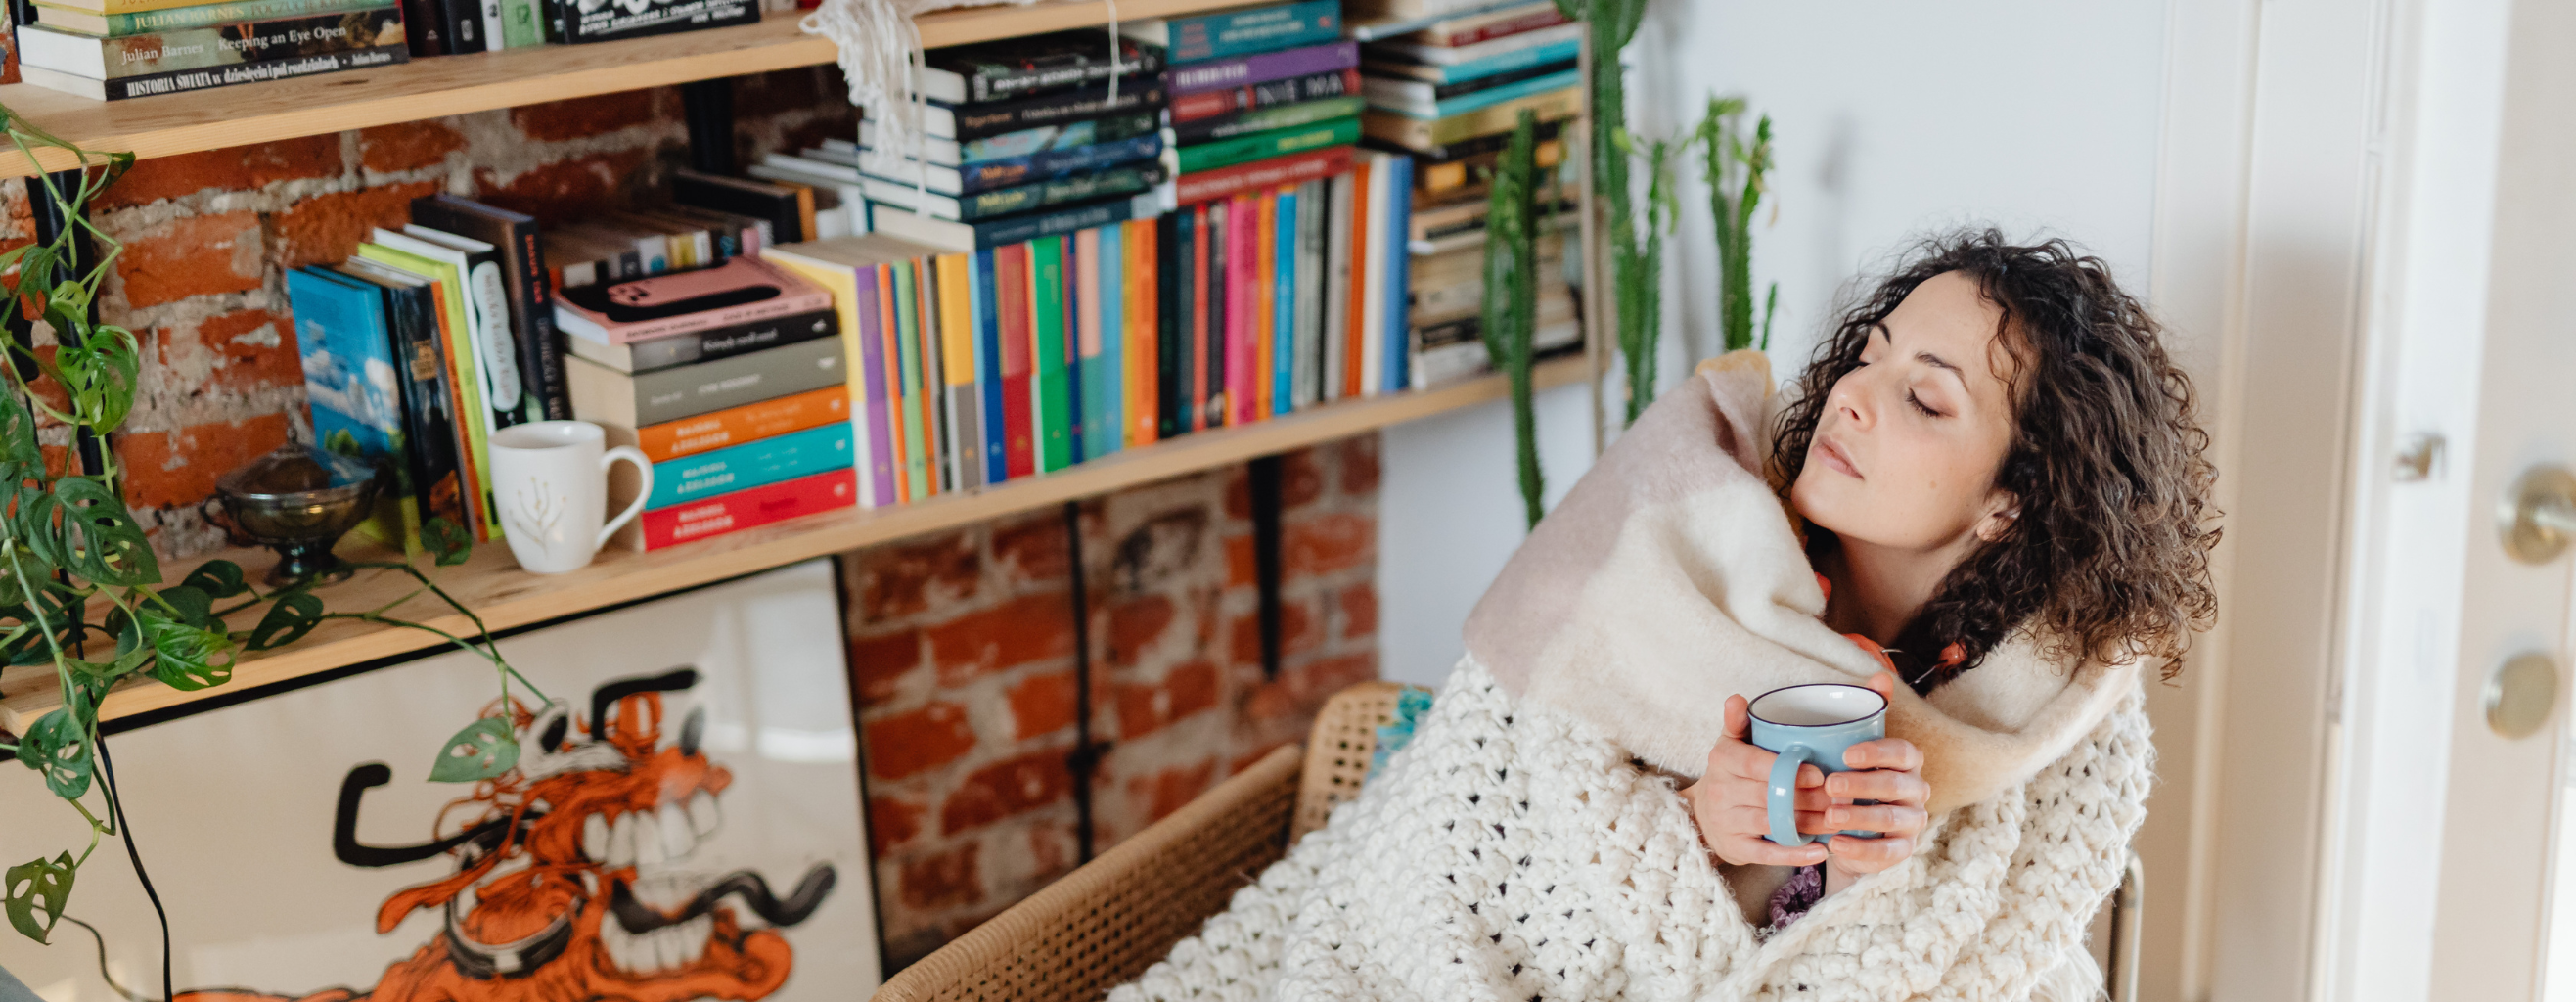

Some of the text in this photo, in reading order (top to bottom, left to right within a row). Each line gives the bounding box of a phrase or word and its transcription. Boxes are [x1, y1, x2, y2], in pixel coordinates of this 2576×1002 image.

[135, 13, 185, 30] JULIAN
[189, 6, 245, 23] BARNES
[121, 26, 347, 65] Julian Barnes Keeping an Eye Open
[127, 77, 176, 97] HISTORIA
[176, 71, 213, 90] ŚWIATA
[212, 73, 223, 85] w
